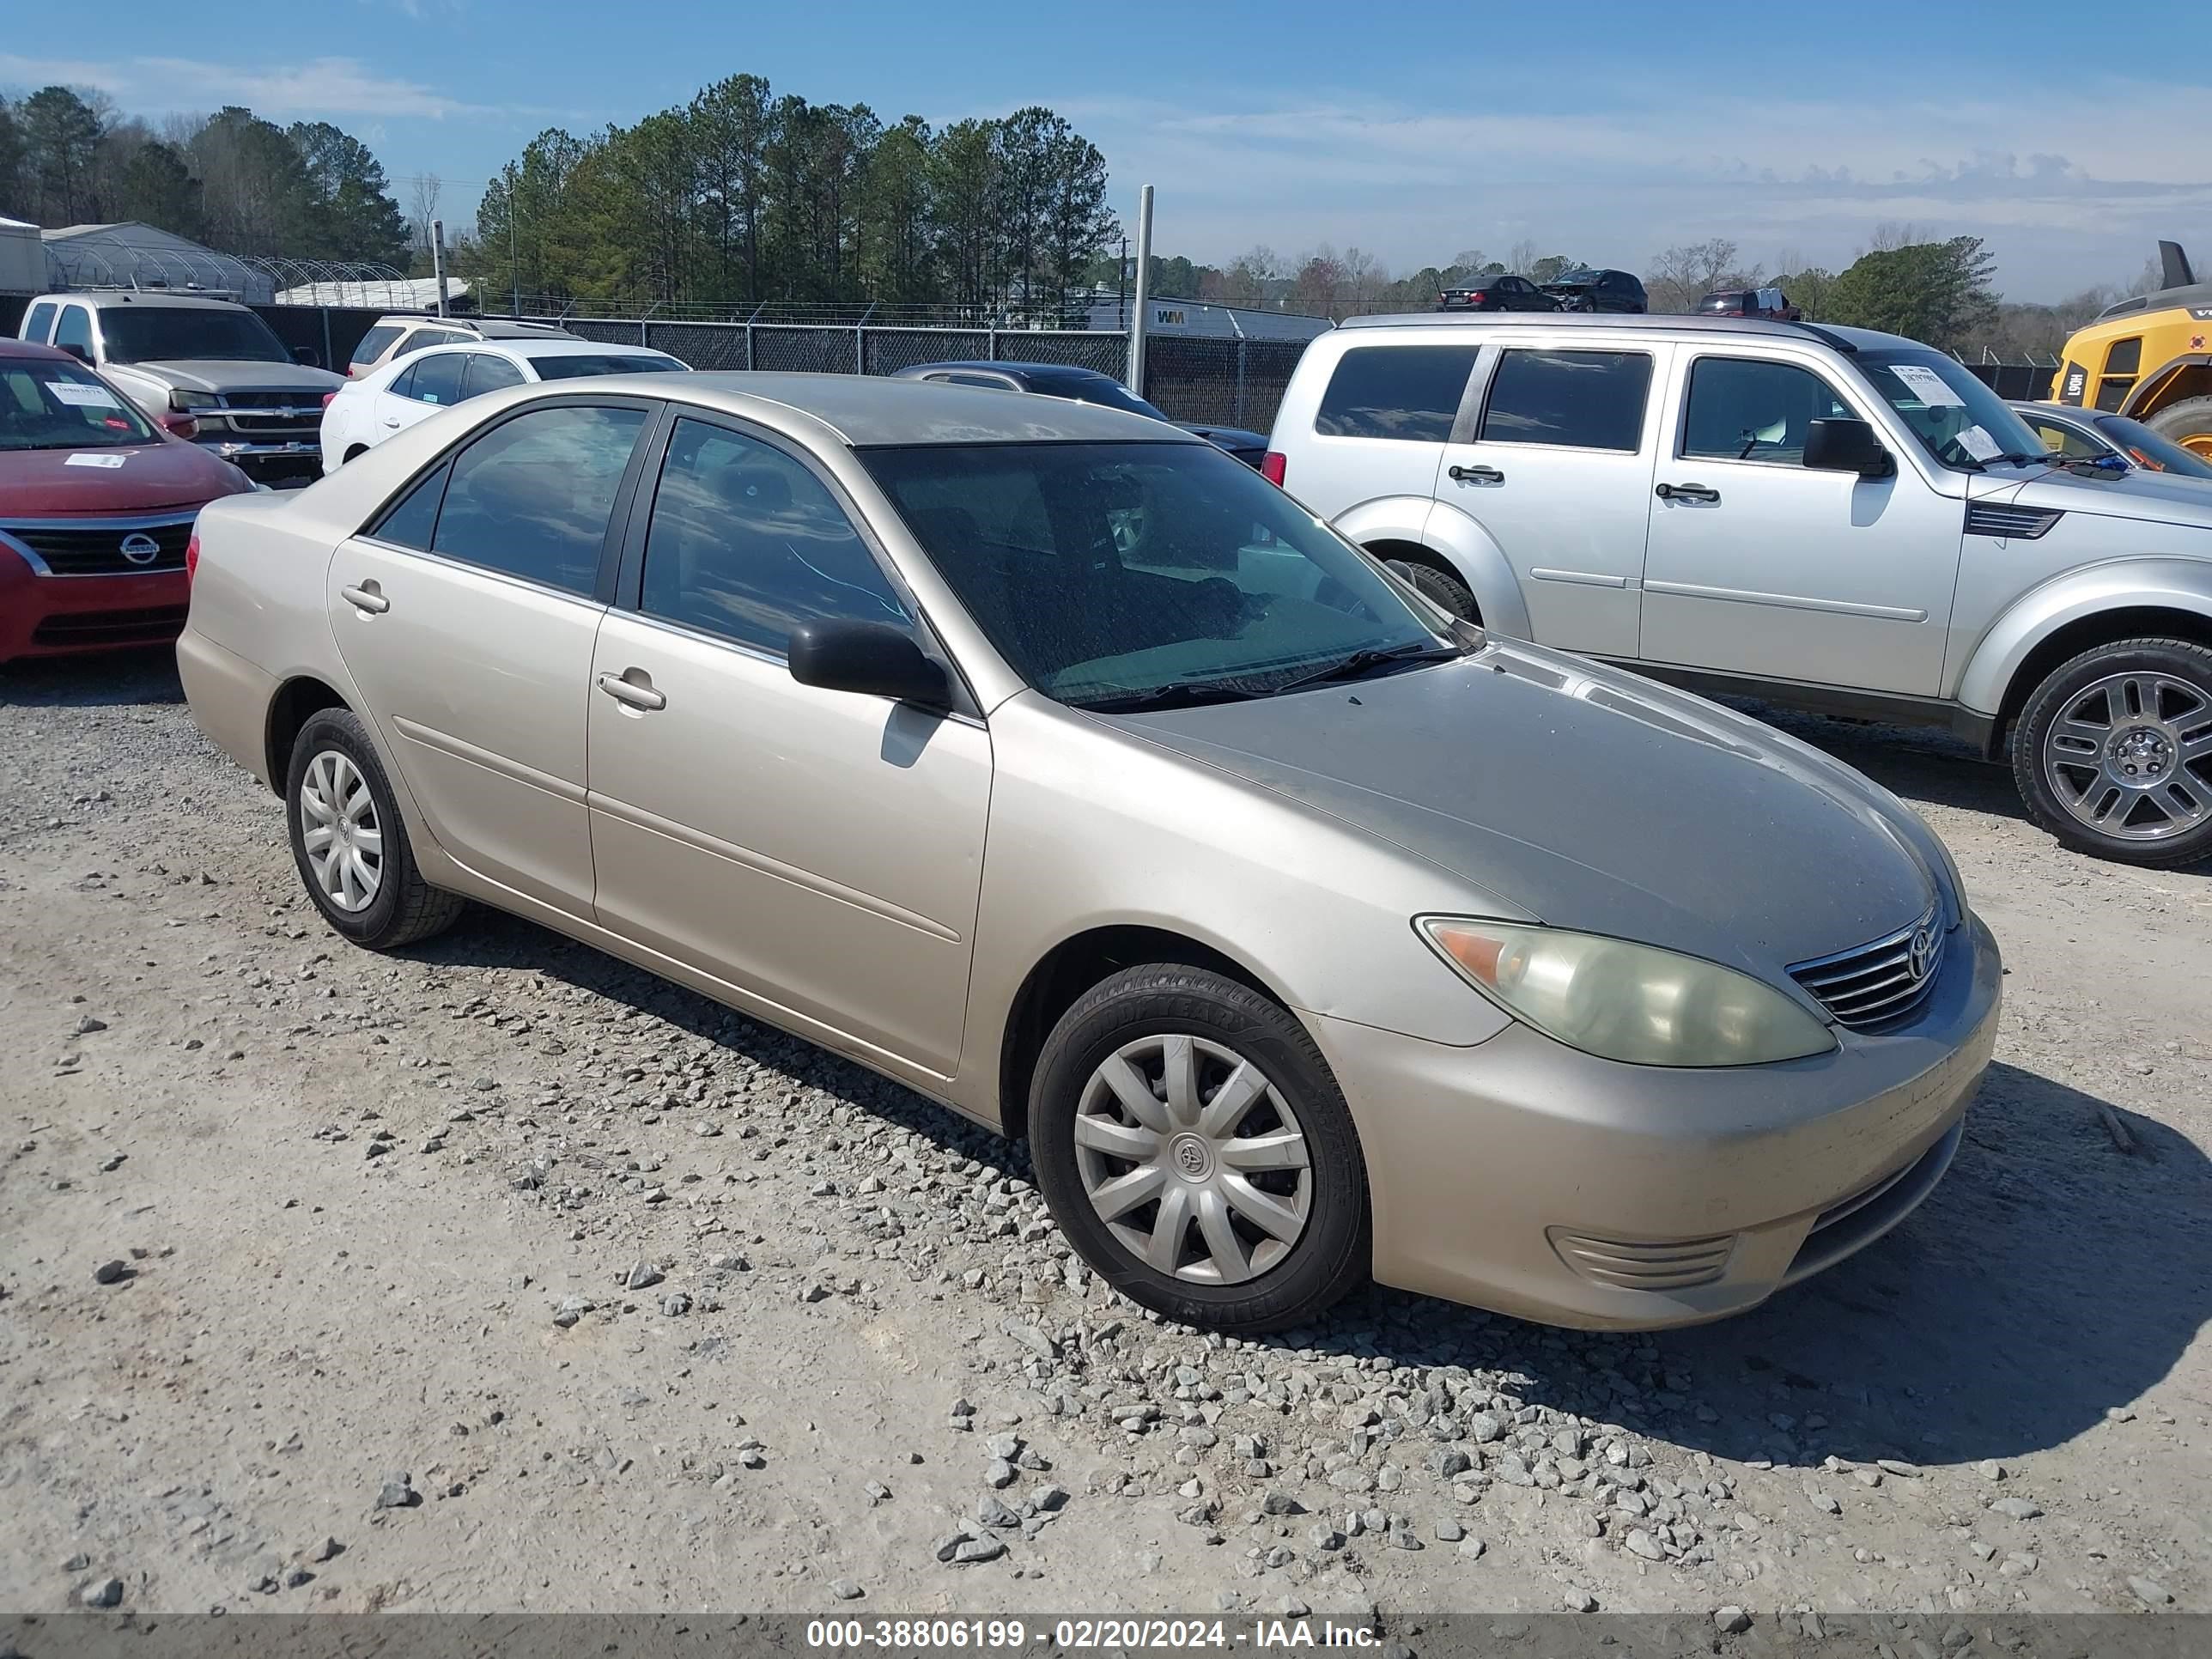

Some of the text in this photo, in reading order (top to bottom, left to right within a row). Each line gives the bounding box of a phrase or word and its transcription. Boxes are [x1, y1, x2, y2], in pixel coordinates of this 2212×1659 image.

[1158, 310, 1185, 324] WM
[2067, 374, 2083, 396] L90H
[125, 544, 157, 553] NISSAN
